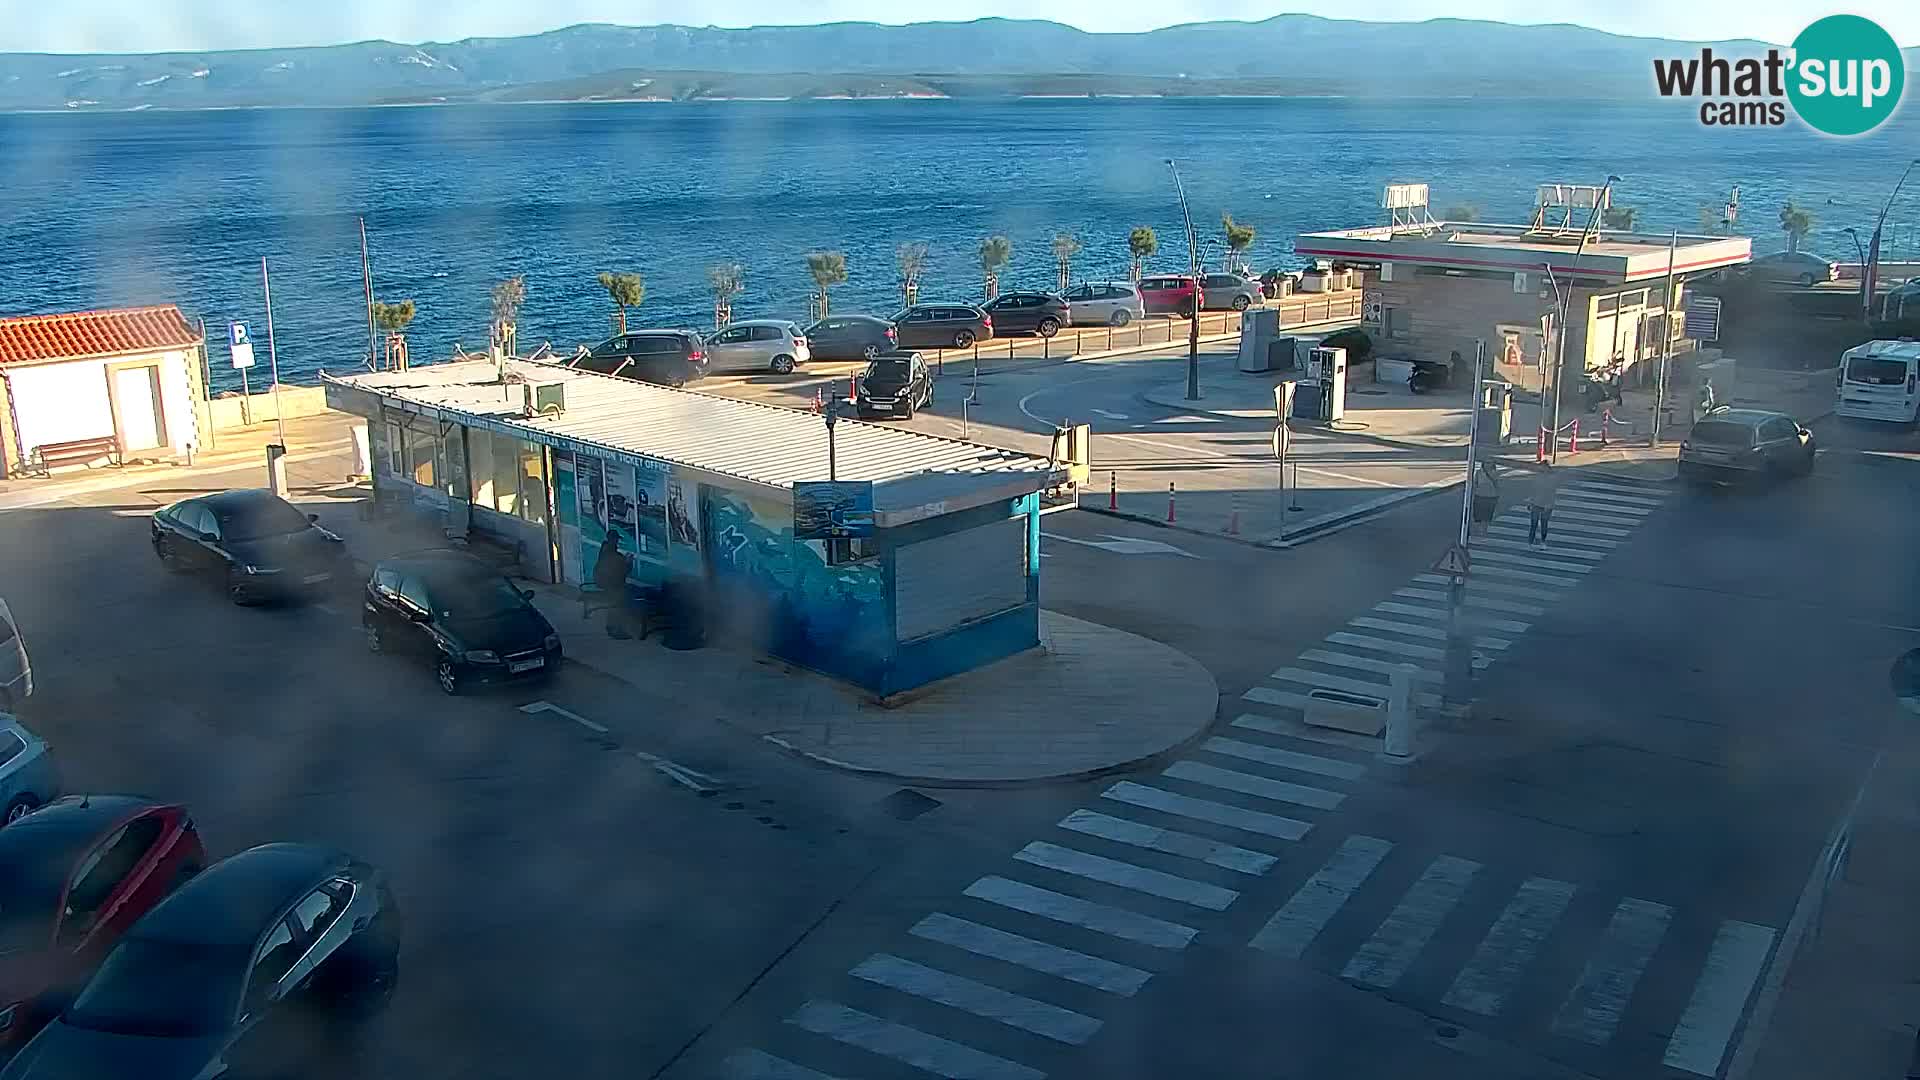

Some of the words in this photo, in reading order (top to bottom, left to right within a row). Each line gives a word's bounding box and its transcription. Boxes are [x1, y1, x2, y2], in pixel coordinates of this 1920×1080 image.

[233, 325, 246, 344] P
[585, 445, 617, 461] STATION
[619, 453, 643, 468] TICKET
[645, 459, 672, 473] OFFICE
